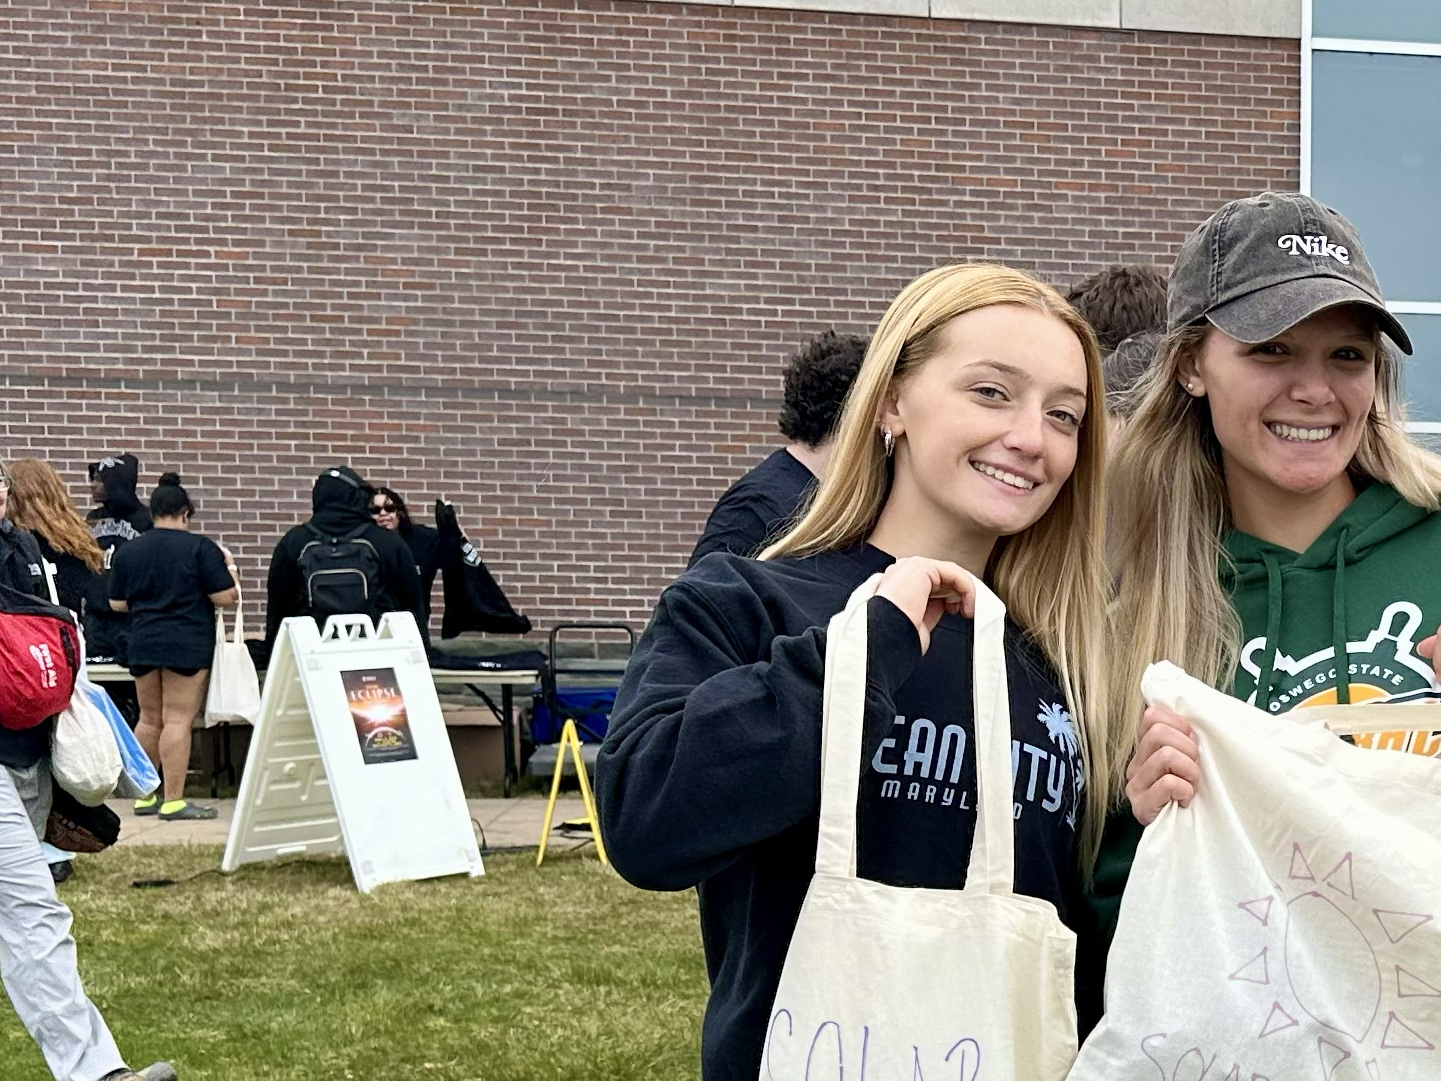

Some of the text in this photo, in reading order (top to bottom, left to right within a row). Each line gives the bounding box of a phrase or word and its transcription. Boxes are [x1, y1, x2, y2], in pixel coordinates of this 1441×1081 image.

[1277, 233, 1350, 266] Nike
[1268, 663, 1405, 713] OSWEGO STATE
